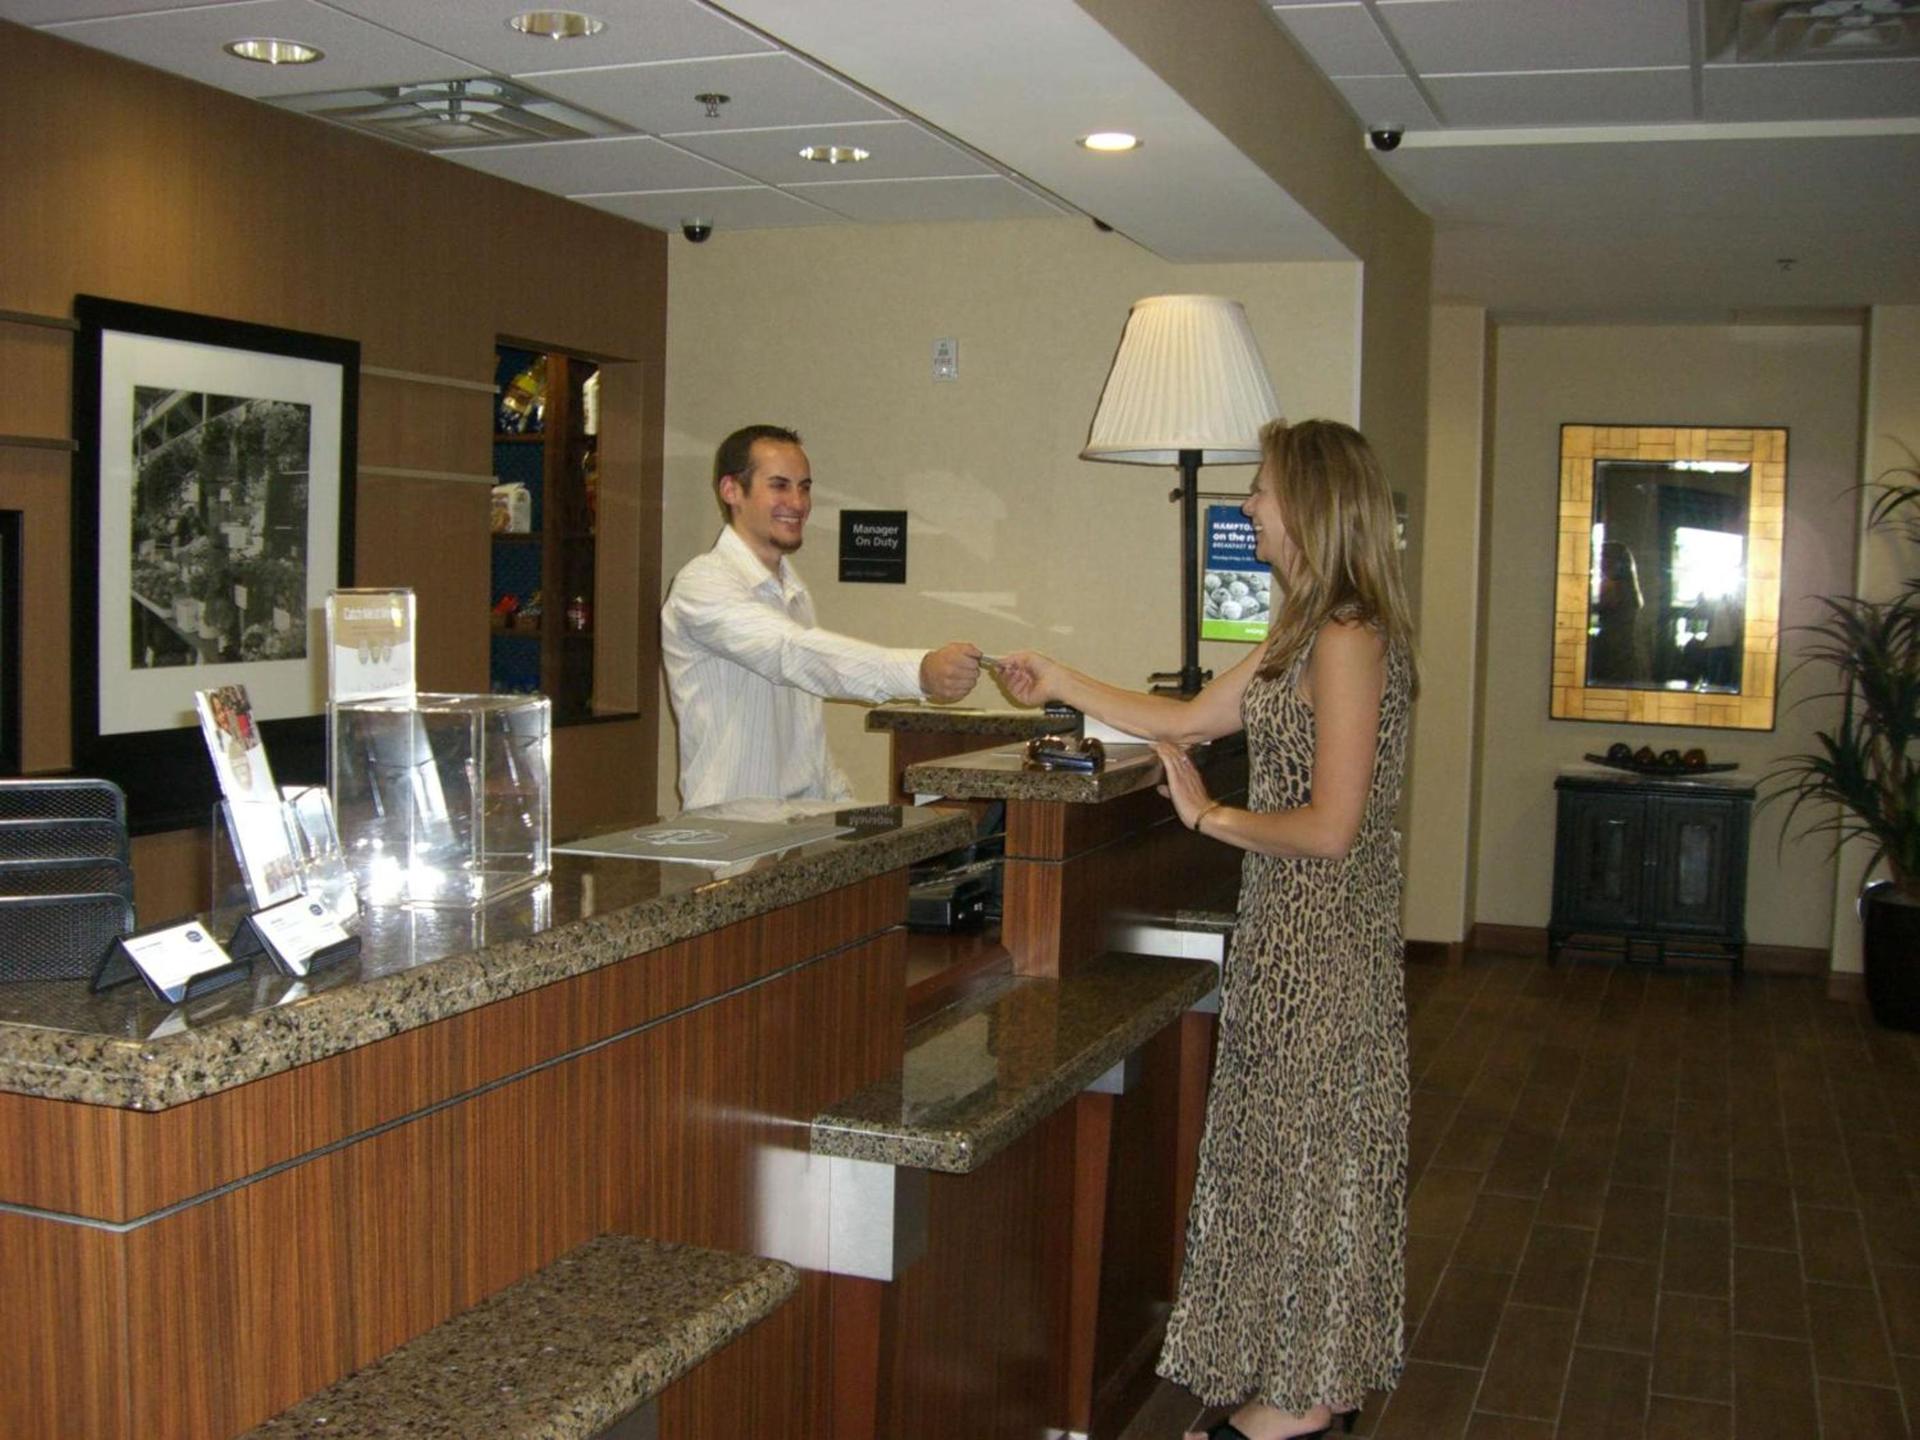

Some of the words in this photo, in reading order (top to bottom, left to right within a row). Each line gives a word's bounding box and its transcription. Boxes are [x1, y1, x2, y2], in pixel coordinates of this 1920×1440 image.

[852, 524, 899, 537] Manager
[1212, 532, 1227, 541] on
[1228, 531, 1245, 542] the
[855, 536, 871, 546] On
[873, 537, 899, 549] Duty
